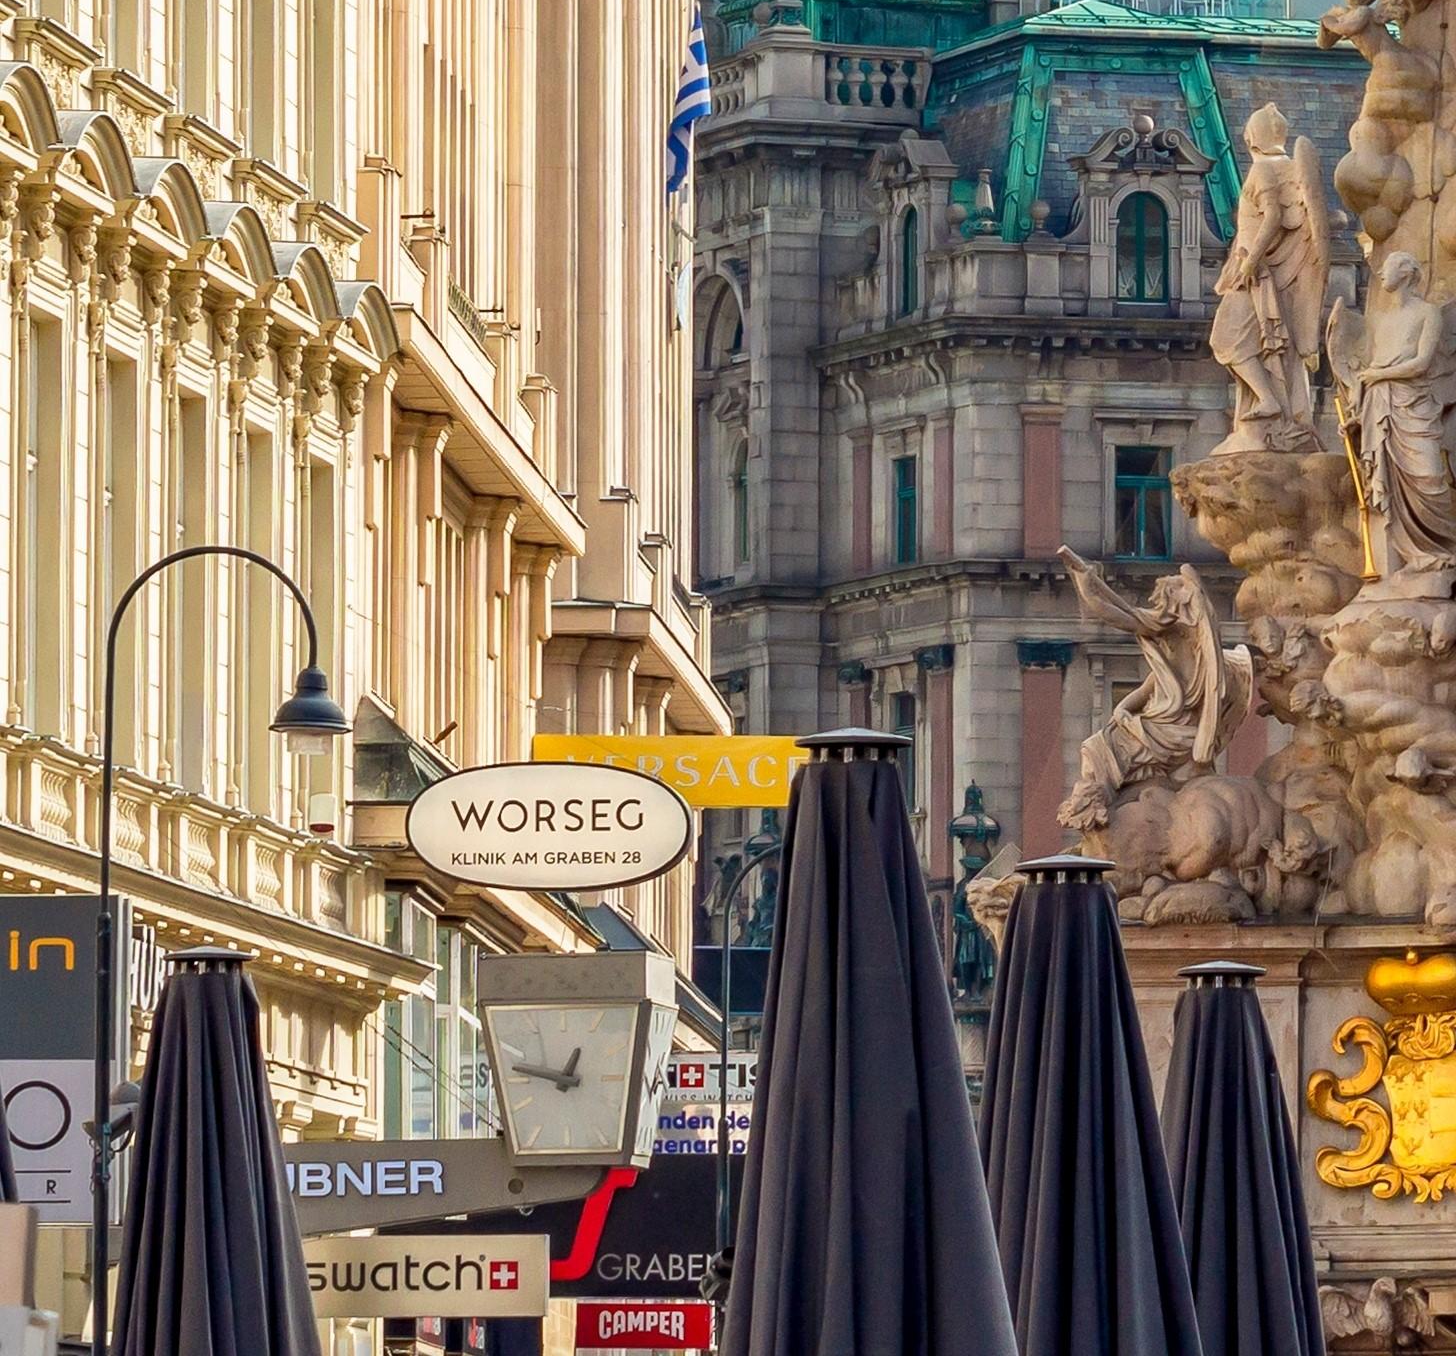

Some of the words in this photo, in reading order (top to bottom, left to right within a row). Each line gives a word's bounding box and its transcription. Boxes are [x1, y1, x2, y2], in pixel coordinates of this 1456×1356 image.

[451, 799, 644, 832] WORSEG
[451, 852, 506, 866] KLINIK
[512, 852, 538, 865] AM
[544, 851, 616, 865] GRABEN
[621, 851, 641, 864] 28
[10, 931, 74, 971] in
[305, 1254, 483, 1292] swatch
[597, 1253, 711, 1281] GRABE
[598, 1310, 685, 1340] CAMPER
